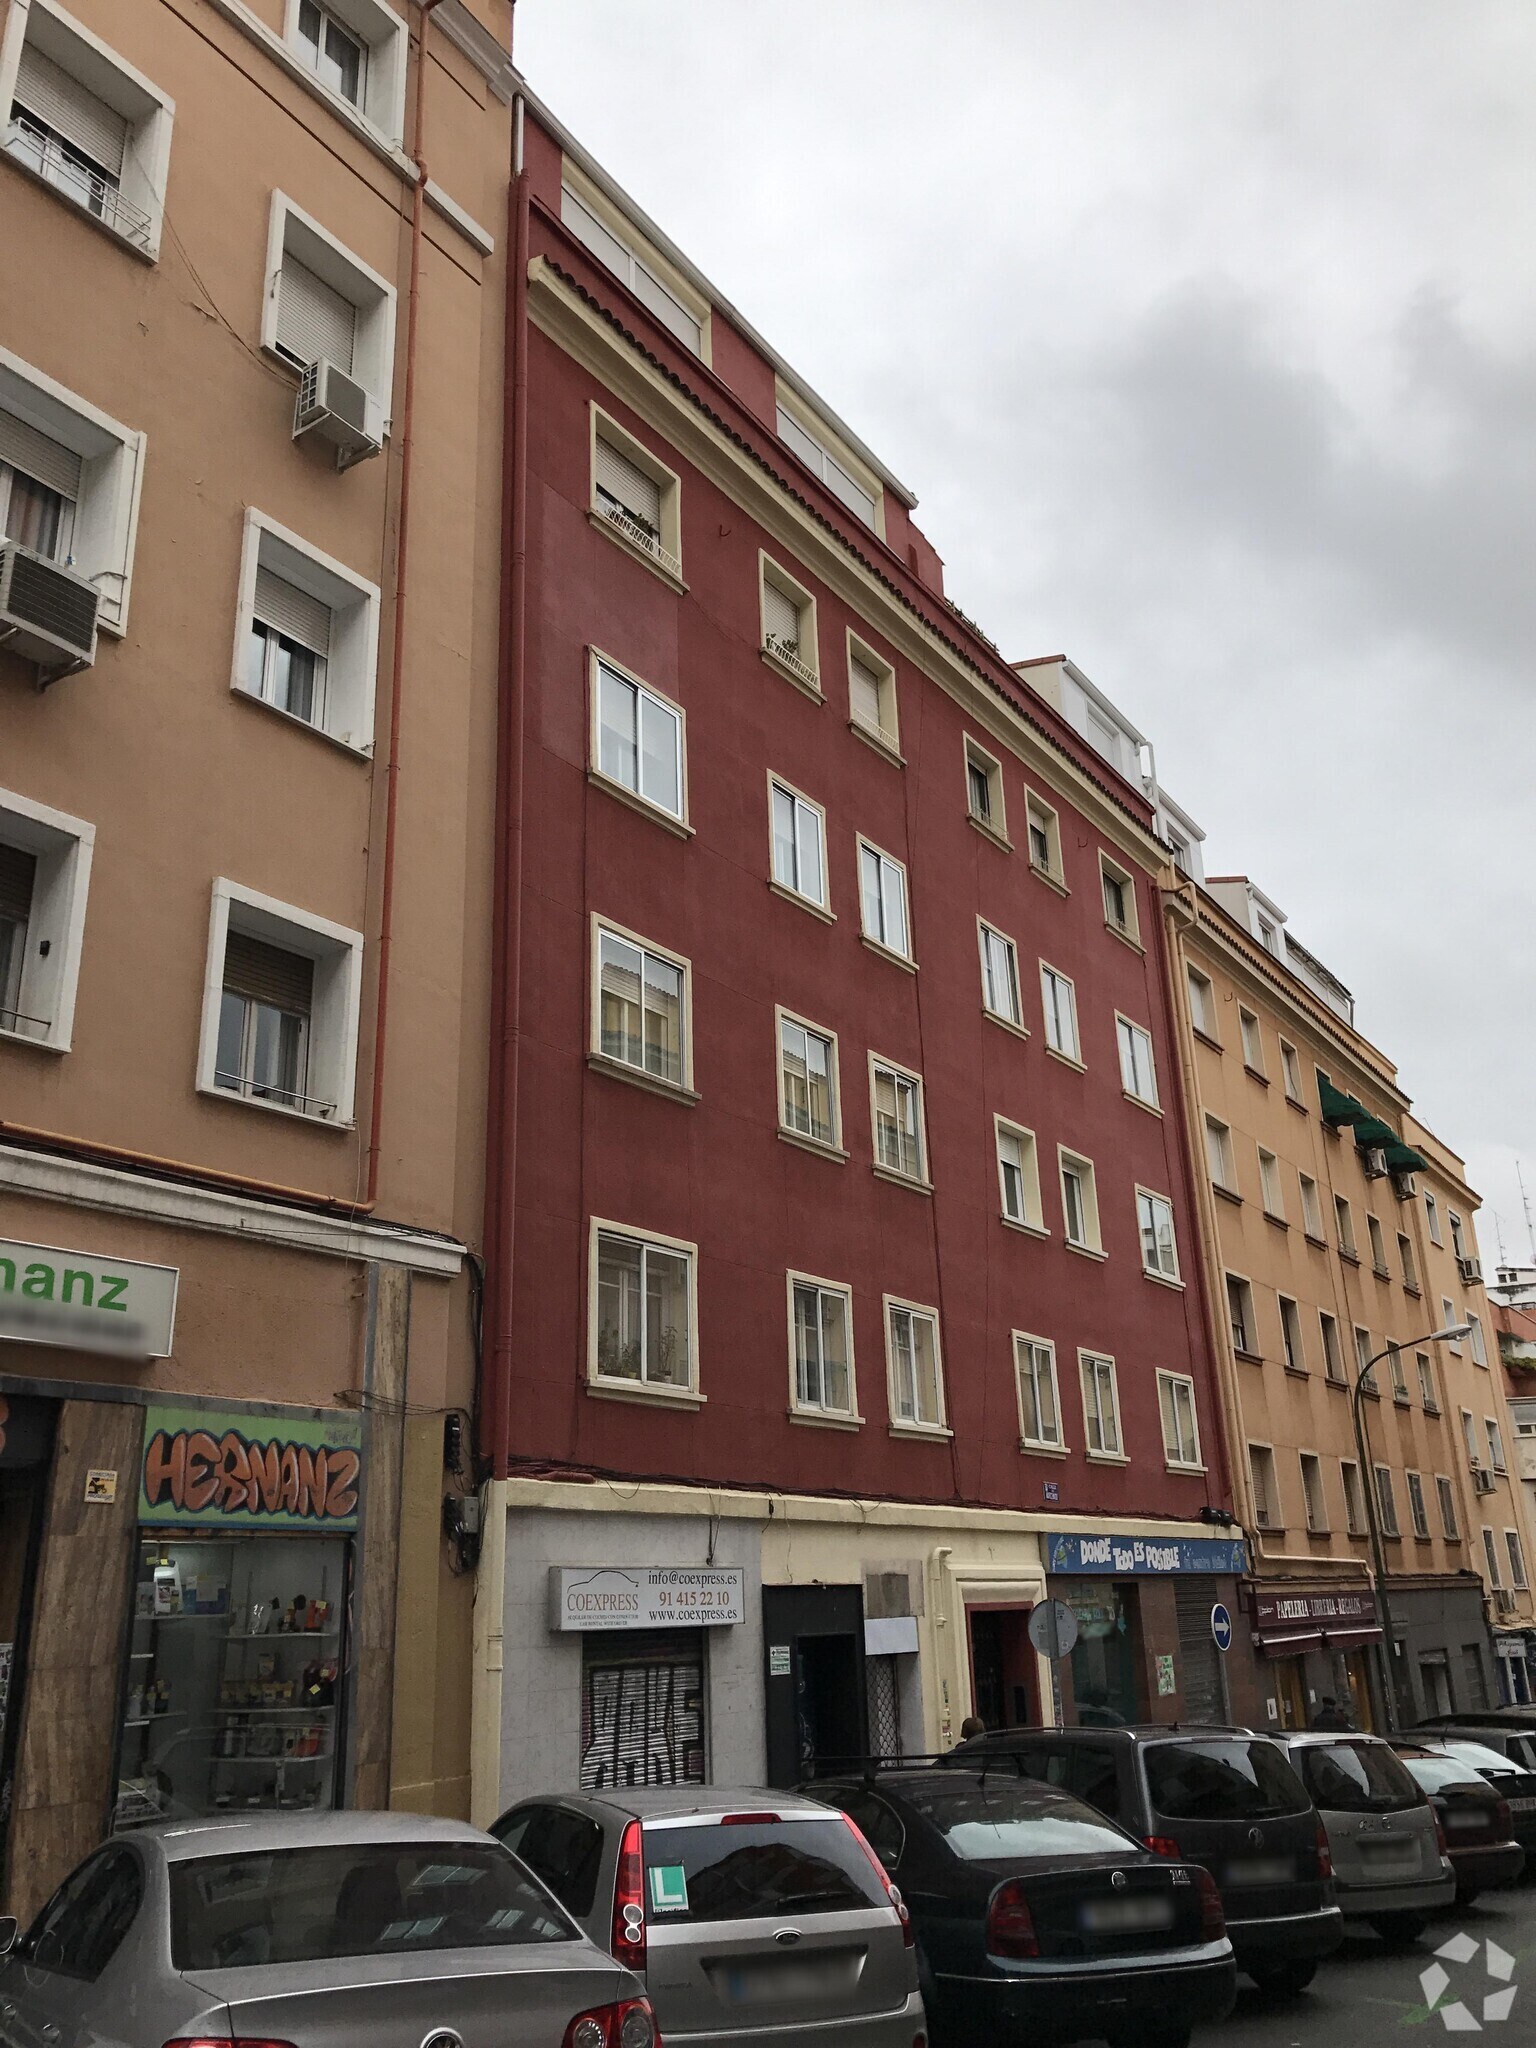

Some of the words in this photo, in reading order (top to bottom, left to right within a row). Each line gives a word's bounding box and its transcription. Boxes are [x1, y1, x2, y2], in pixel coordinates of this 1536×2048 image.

[144, 1428, 360, 1518] HERNANZ
[1080, 1537, 1112, 1565] DONDE
[1133, 1541, 1145, 1562] ES
[1145, 1545, 1180, 1571] POSIBLE
[648, 1570, 738, 1588] info@coexpress.es
[567, 1593, 639, 1612] COEXPRESS
[659, 1591, 673, 1607] 91
[676, 1591, 697, 1606] 415
[700, 1591, 714, 1606] 22
[717, 1591, 730, 1606] 10
[648, 1608, 738, 1623] www.coexpress.es
[1276, 1600, 1309, 1619] PAPELERIA
[654, 1867, 683, 1904] L
